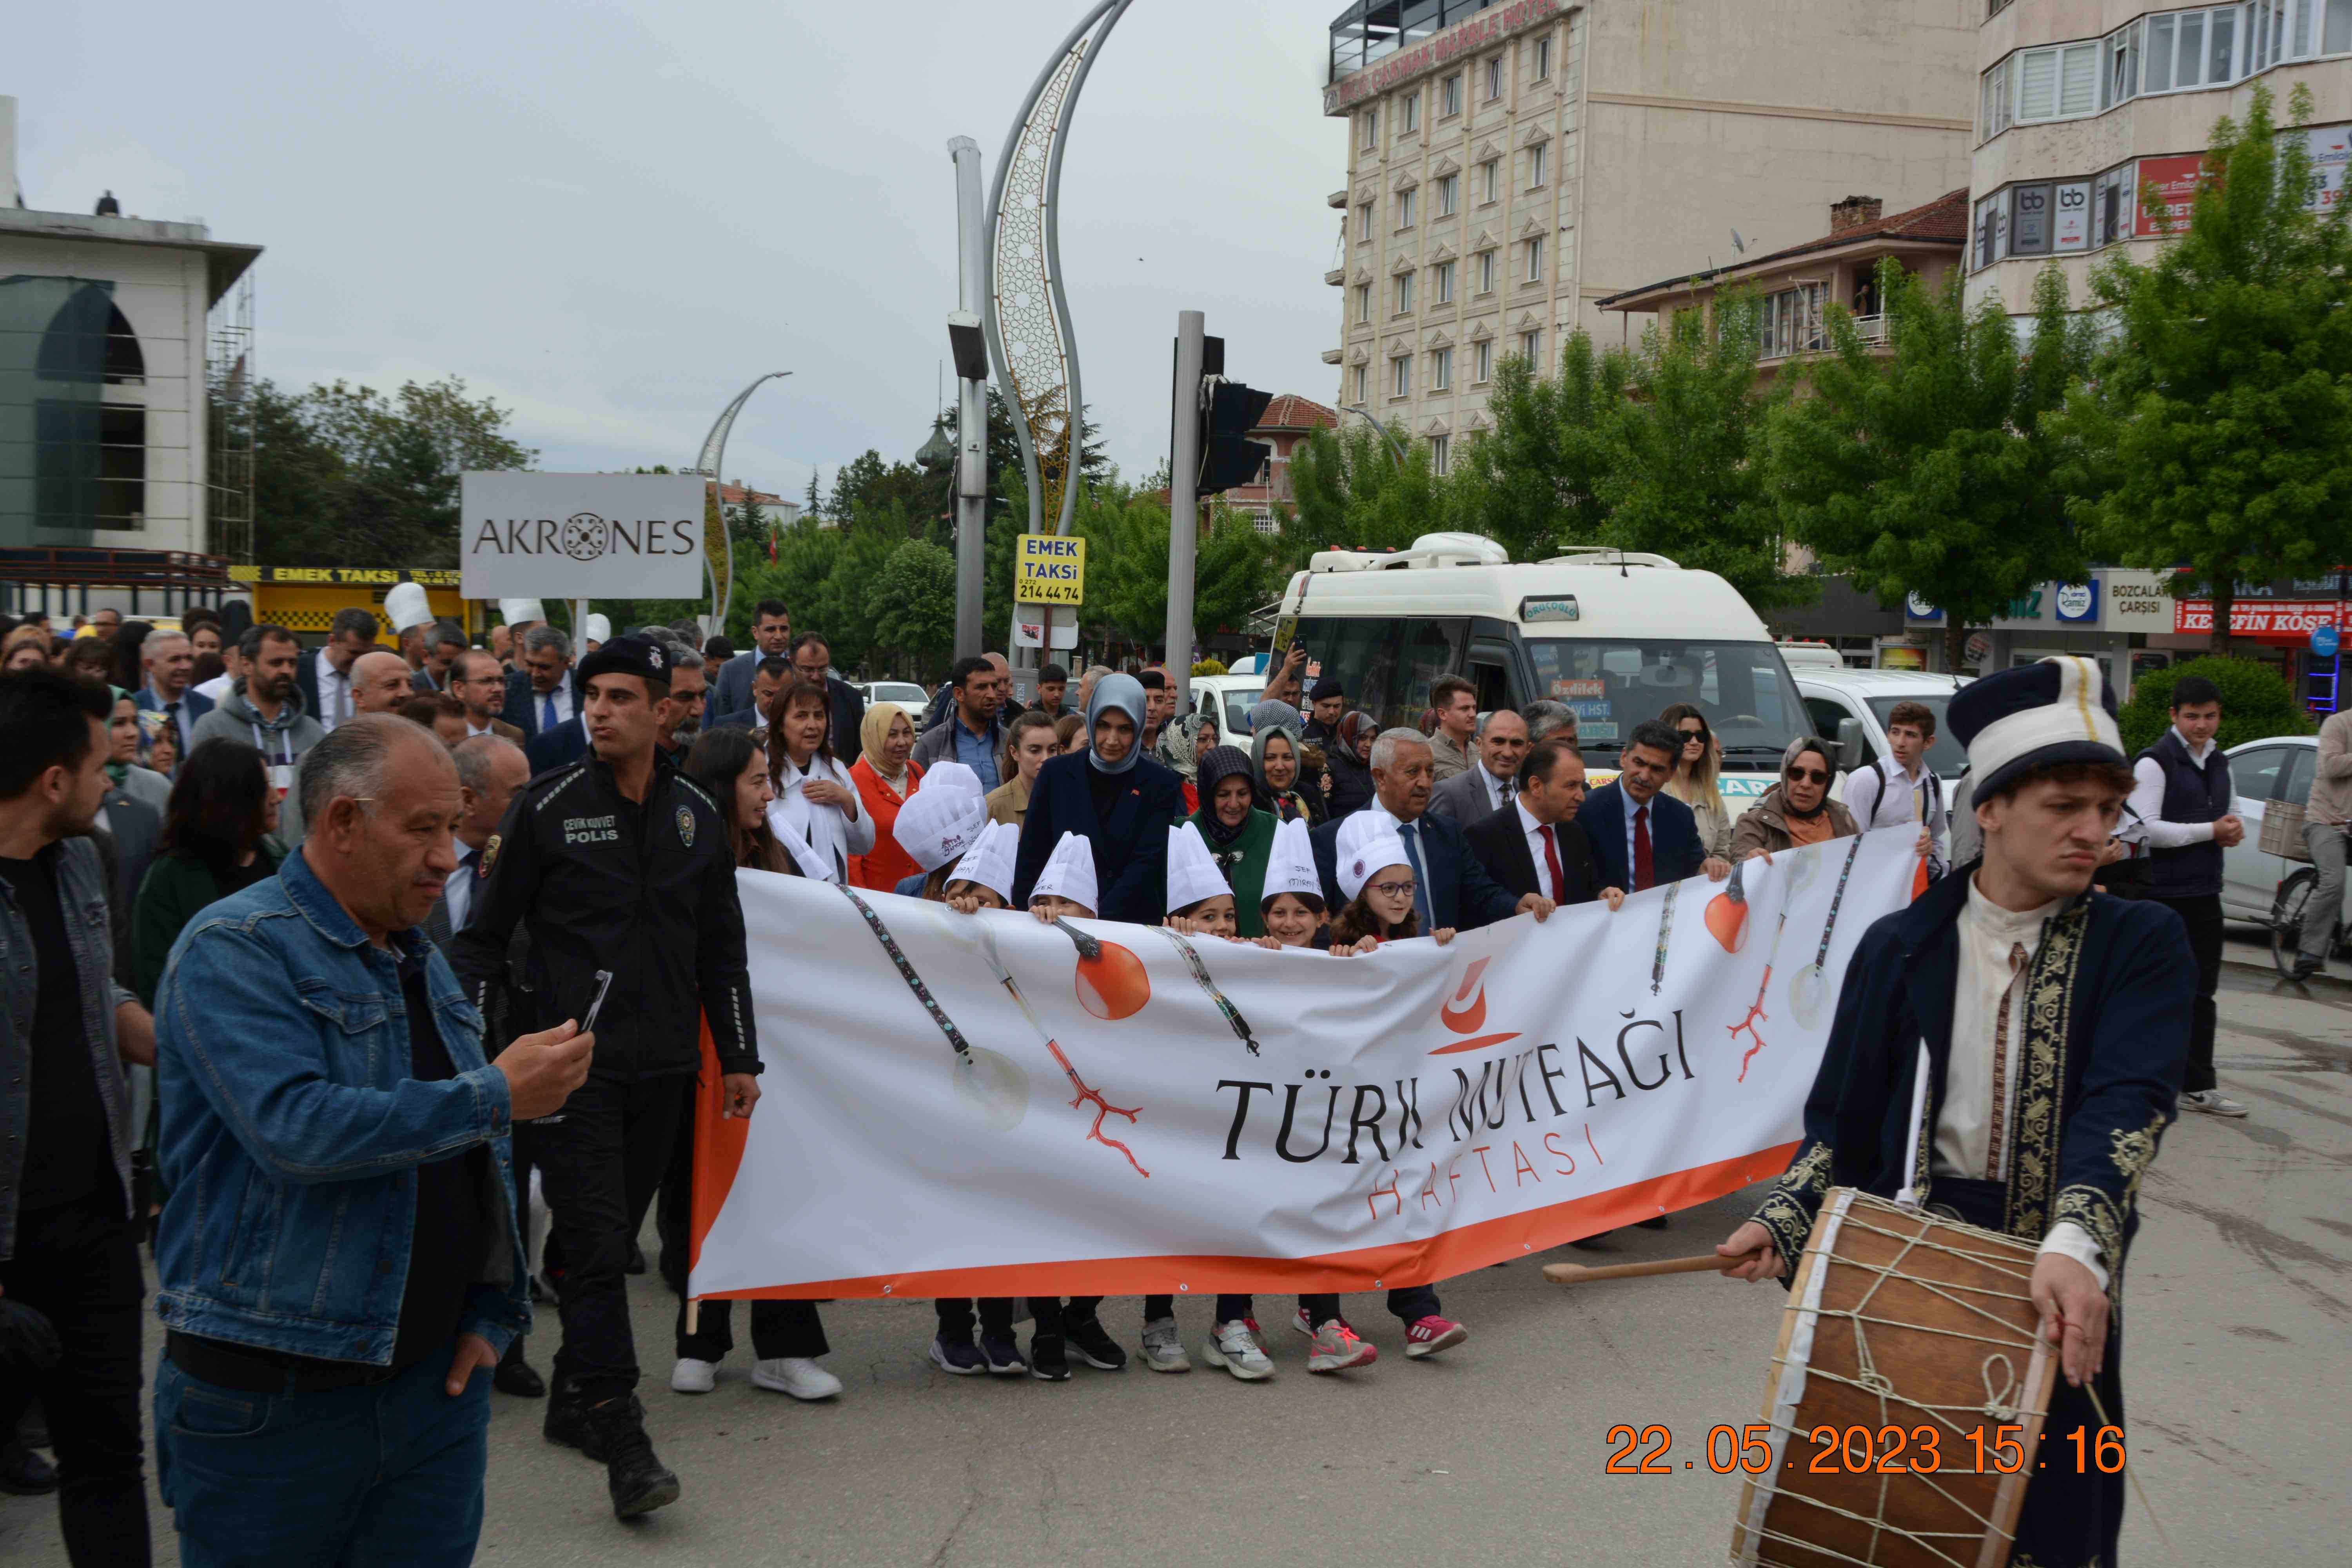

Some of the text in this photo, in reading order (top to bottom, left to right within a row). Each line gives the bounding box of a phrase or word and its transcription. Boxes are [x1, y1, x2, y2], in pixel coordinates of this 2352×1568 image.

[1435, 13, 1501, 60] MARBLE
[1502, 0, 1560, 31] HOTEL
[1027, 539, 1078, 557] EMEK
[273, 568, 333, 581] EMEK
[1020, 585, 1078, 600] 214 44 74
[2120, 601, 2160, 615] ÇARŞISI
[1553, 680, 1602, 695] Özdilek
[1216, 1007, 1695, 1163] TÜRK MUTFAĞI
[1368, 1123, 1604, 1220] HAFTASI
